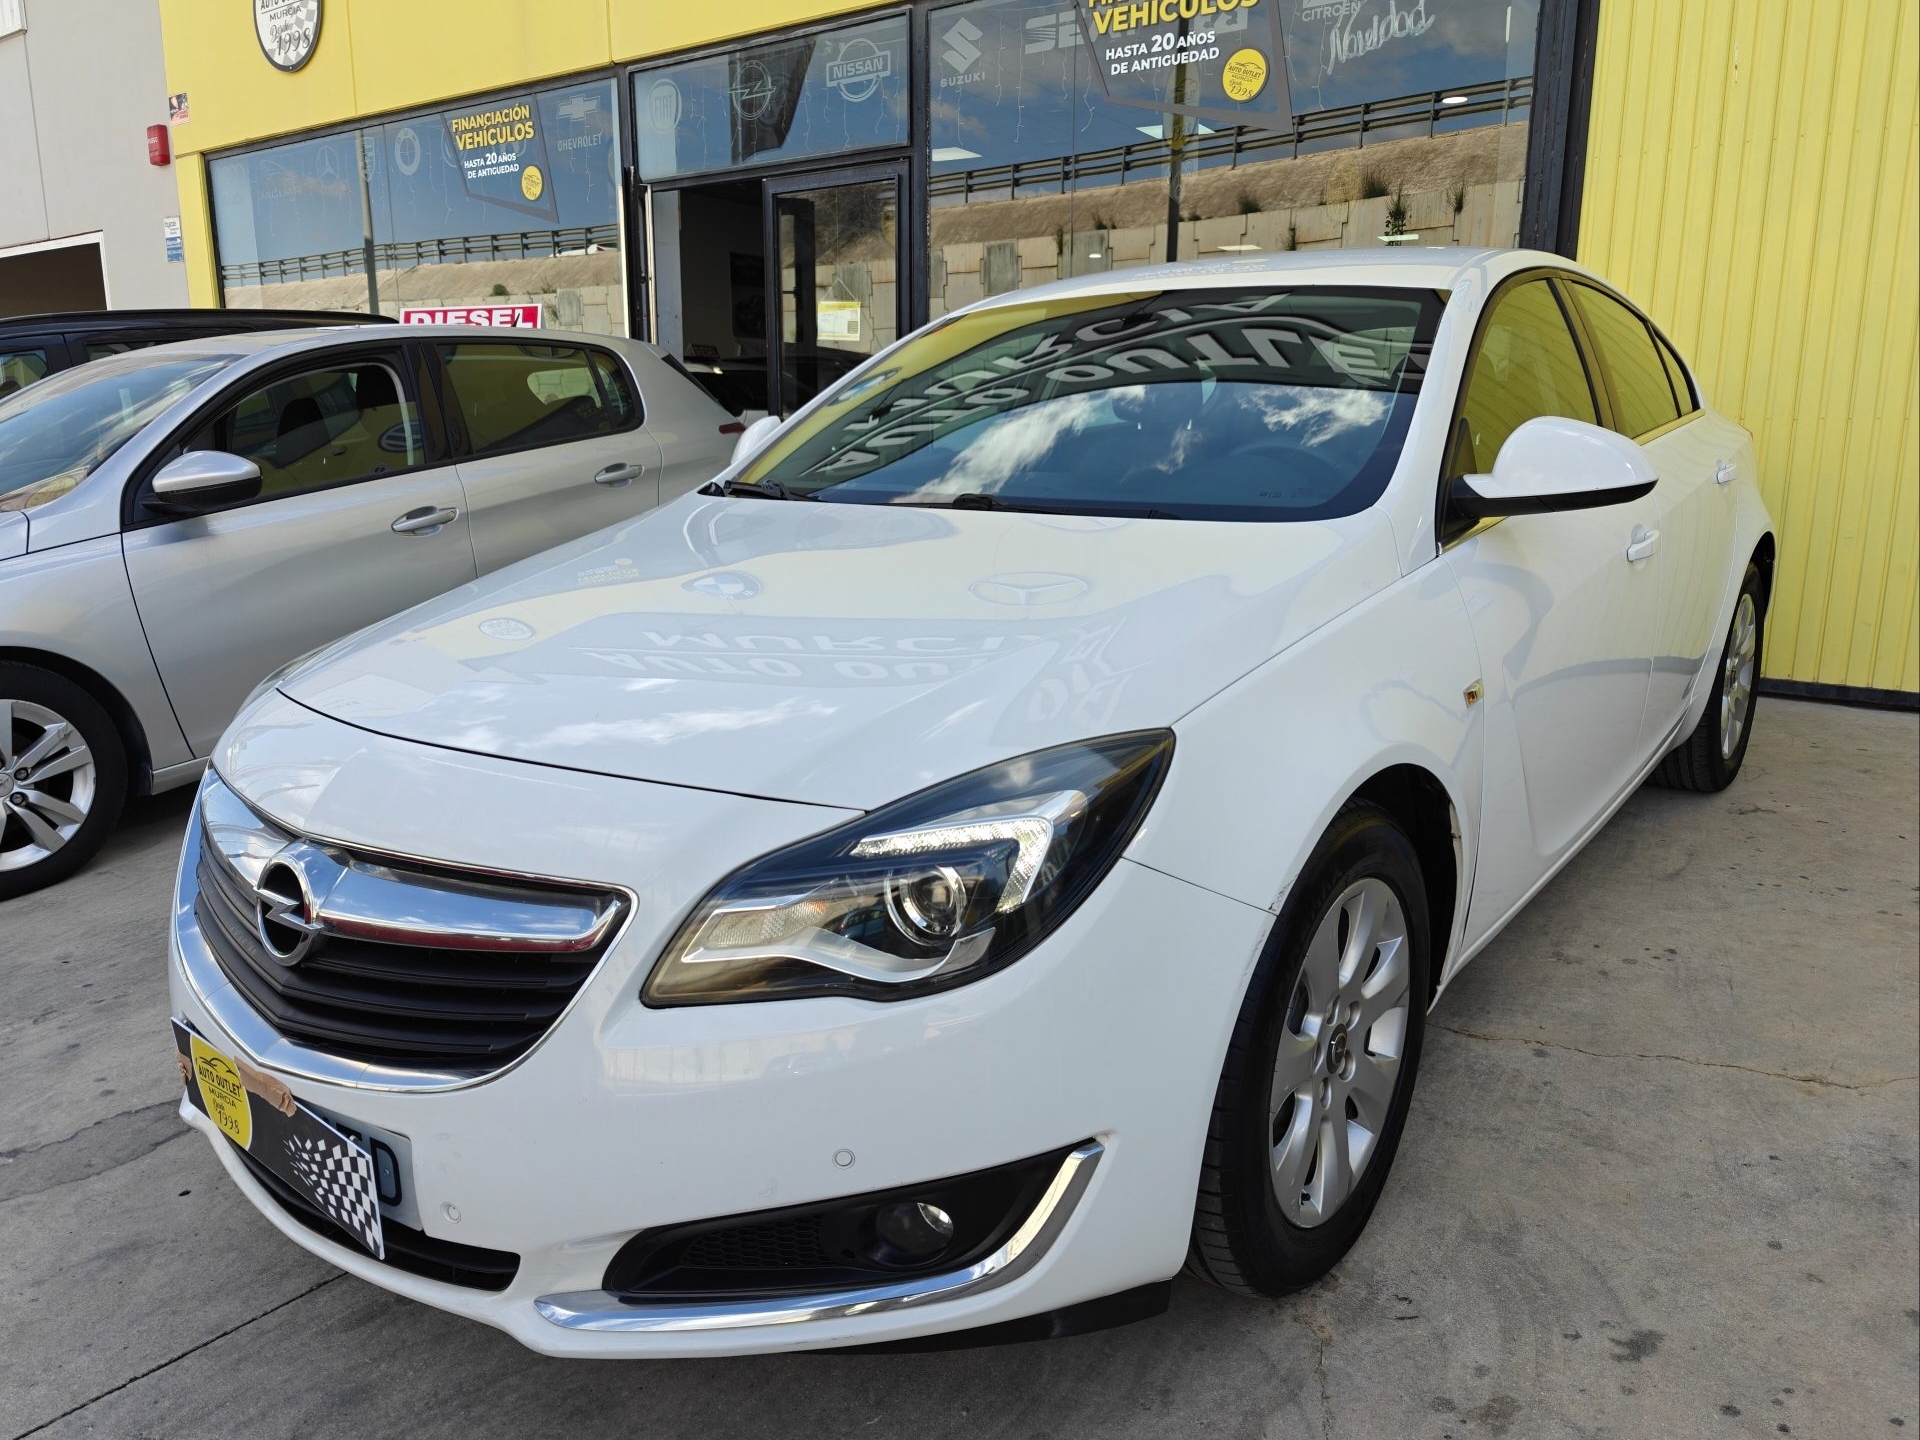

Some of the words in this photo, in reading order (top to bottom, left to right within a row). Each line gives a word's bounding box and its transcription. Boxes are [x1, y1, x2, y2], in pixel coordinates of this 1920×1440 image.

[269, 5, 302, 20] MURCIA
[277, 28, 311, 55] 1998
[1105, 43, 1148, 61] HASTA
[1151, 32, 1175, 52] 20
[1176, 30, 1216, 48] AÑOS
[833, 58, 883, 79] NISSAN
[1110, 63, 1129, 75] DE
[1131, 47, 1220, 73] ANTIGUEDAD
[940, 71, 986, 88] SUZUKI
[1230, 86, 1254, 97] 1998
[452, 103, 529, 132] FINANCIACIÓN
[455, 121, 534, 150] VEHÍCULOS
[557, 133, 602, 151] CHEVROLET
[464, 158, 485, 168] HASTA
[485, 152, 497, 165] 20
[498, 153, 516, 163] AÑOS
[467, 171, 476, 179] DE
[477, 164, 519, 177] ANTIGUEDAD
[410, 308, 534, 328] DIESEL
[199, 1064, 215, 1084] AUTO
[216, 1074, 241, 1097] OUTLET
[208, 1086, 237, 1108] MURCIA
[219, 1110, 240, 1134] 1998
